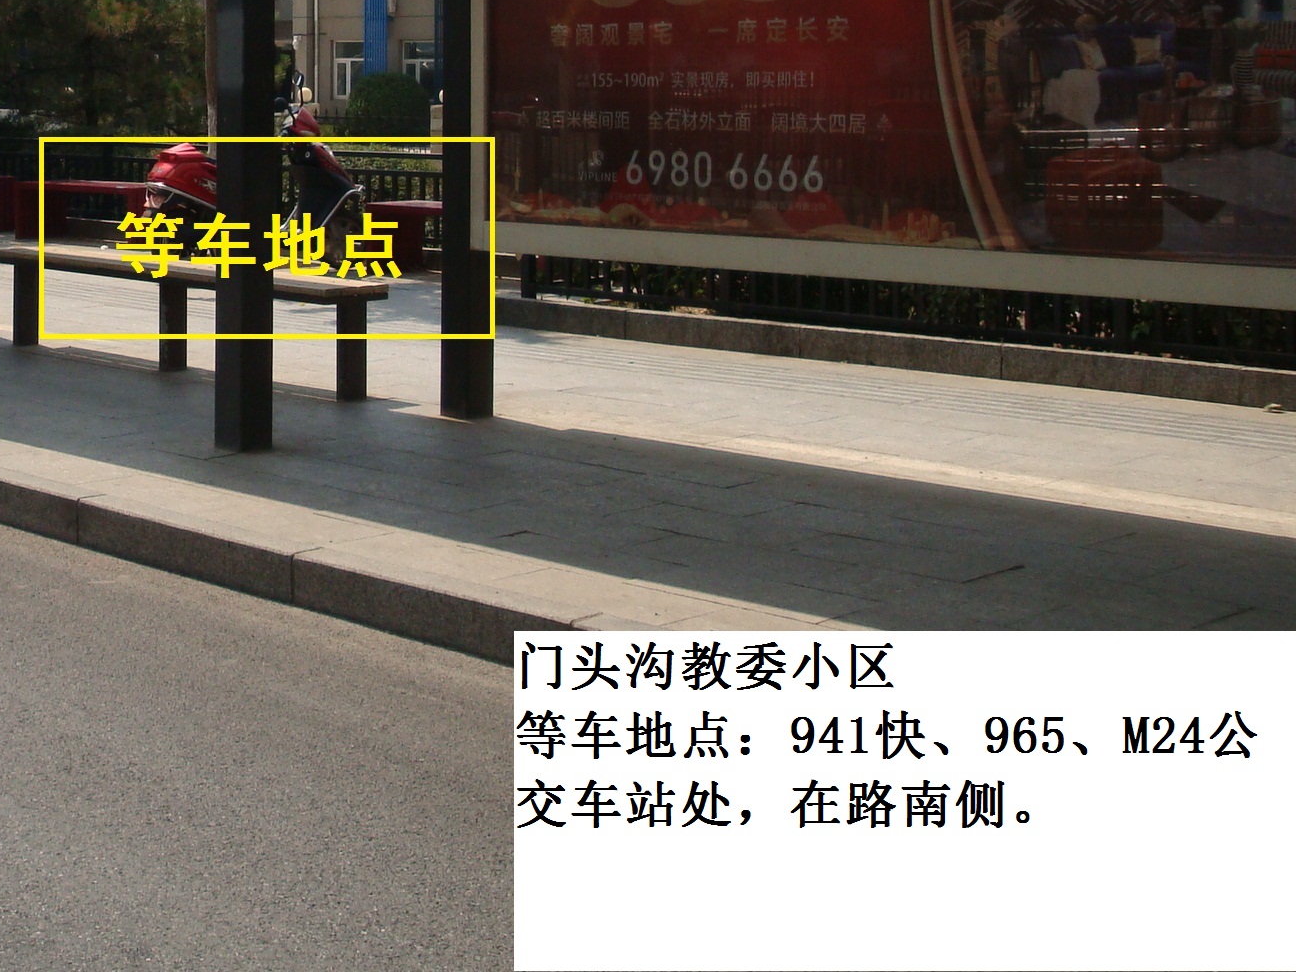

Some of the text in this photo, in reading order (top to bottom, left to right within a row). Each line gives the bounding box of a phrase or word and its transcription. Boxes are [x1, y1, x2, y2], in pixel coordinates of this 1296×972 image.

[550, 15, 850, 48] 奢阔观景宅 一席定长安
[536, 110, 867, 135] 超百米楼间距 全石材外立面 阔境大四居
[578, 149, 824, 193] VIPLINE 6980 6666
